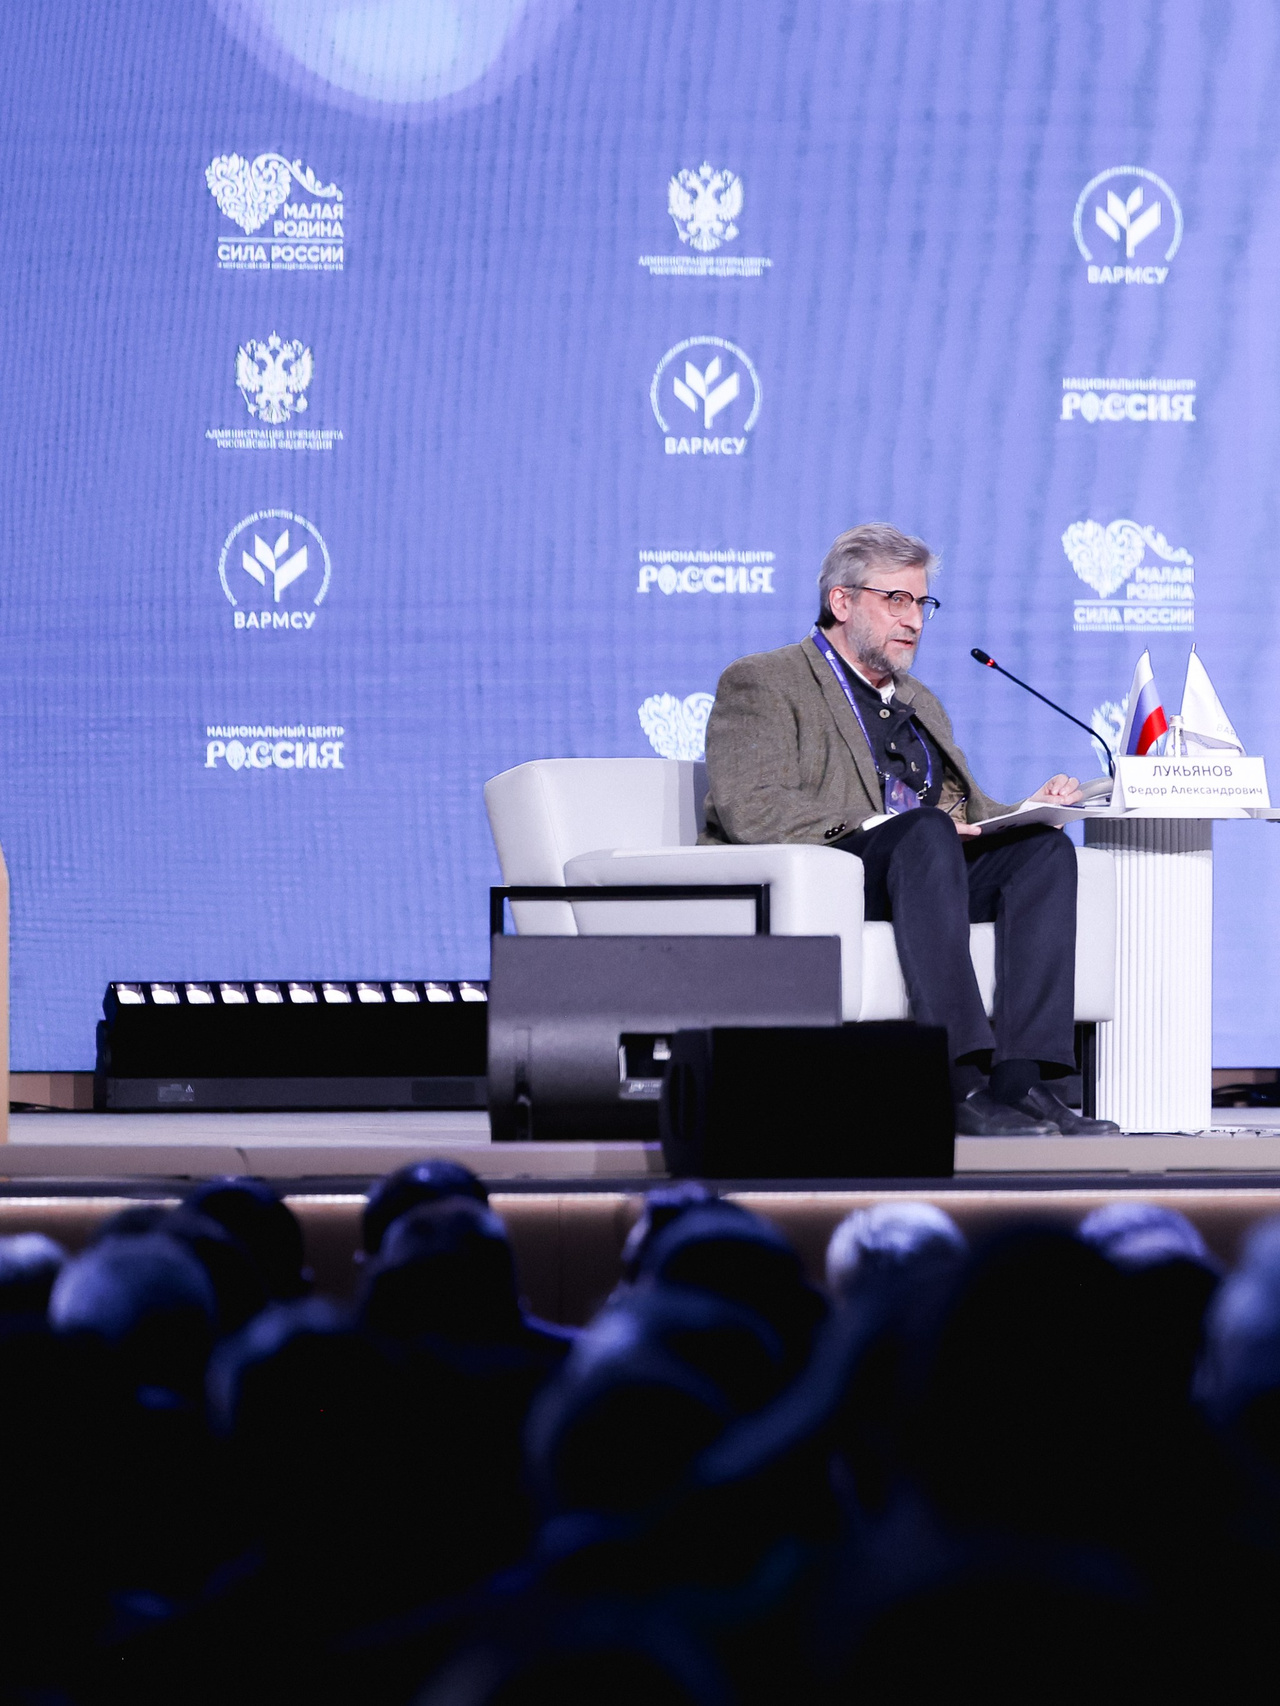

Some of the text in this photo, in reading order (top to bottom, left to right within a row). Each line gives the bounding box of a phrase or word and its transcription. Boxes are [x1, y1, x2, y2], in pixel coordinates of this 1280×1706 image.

[283, 203, 344, 220] МАЛАЯ
[274, 220, 344, 239] РОДИНА
[218, 244, 344, 263] СИЛА РОССИИ
[1087, 265, 1169, 284] ВАРМСУ
[1060, 391, 1196, 423] РОССИЯ
[665, 436, 748, 455] ВАРМСУ
[639, 549, 776, 564] НАЦИОНАЛЬНЫЙ ЦЕНТР
[637, 564, 776, 595] РОССИЯ
[234, 611, 316, 629] ВАРМСУ
[1073, 607, 1195, 624] СИЛА РОССИИ
[207, 724, 345, 739] НАЦИОНАЛЬНЫЙ ЦЕНТР
[204, 739, 345, 771] РОССИЯ
[1152, 765, 1233, 777] ЛУКЬЯНОВ
[1127, 785, 1263, 796] Федор Александрович
